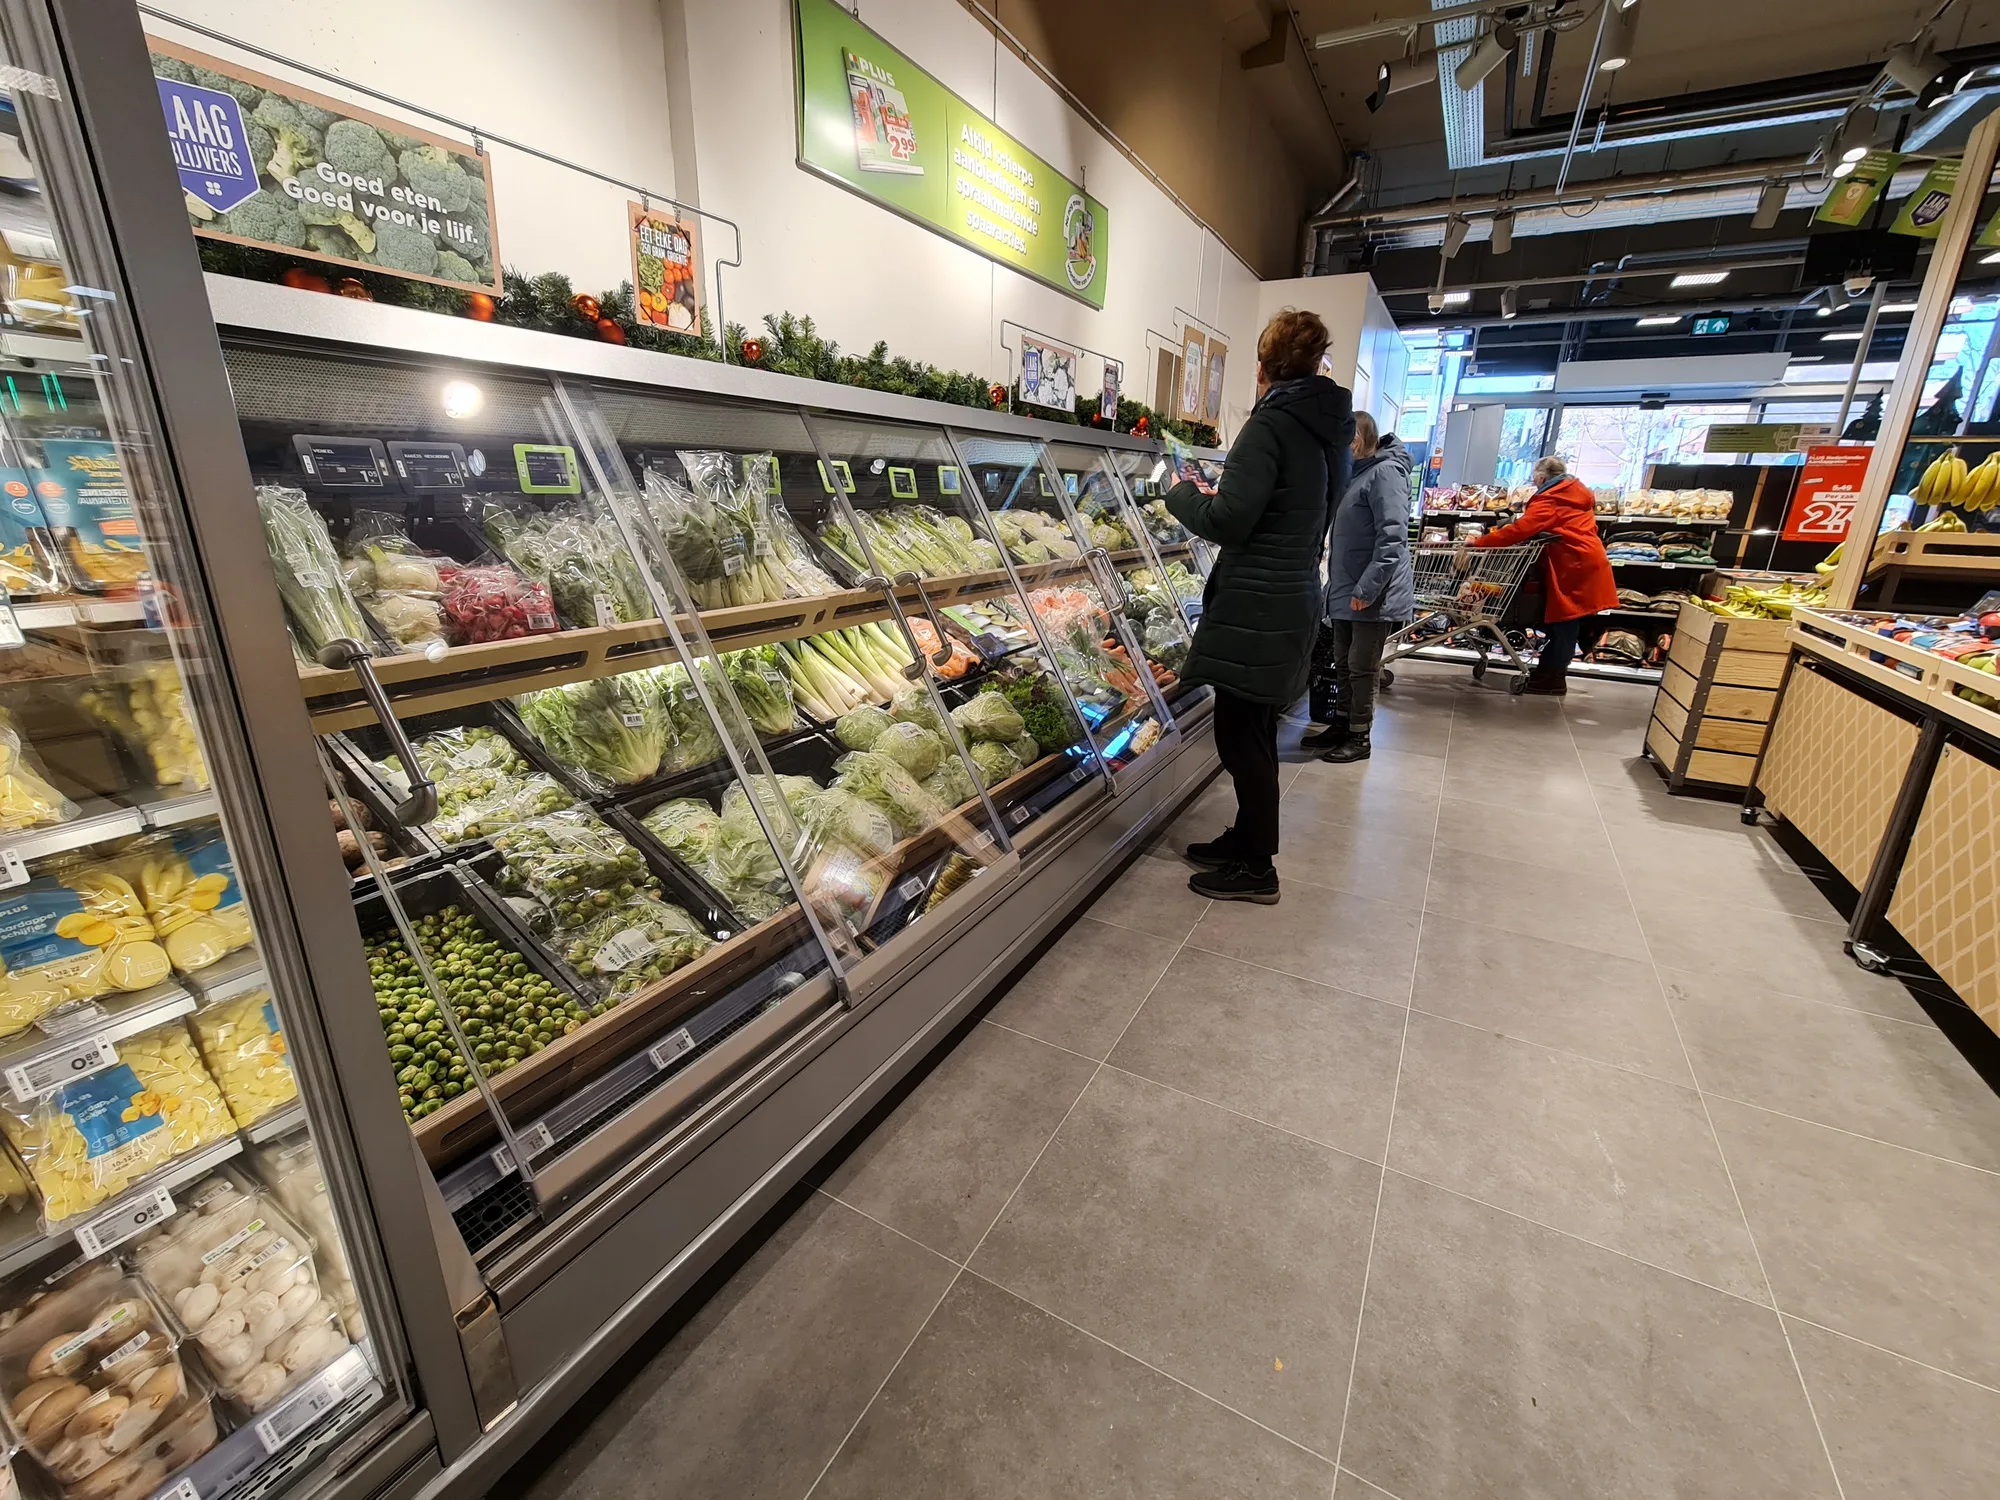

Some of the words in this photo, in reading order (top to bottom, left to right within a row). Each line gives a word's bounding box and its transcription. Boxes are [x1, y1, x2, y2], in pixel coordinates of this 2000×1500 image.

[858, 56, 896, 87] PLUS
[961, 122, 993, 160] Altijd
[995, 150, 1035, 188] scherpe
[315, 161, 385, 197] Goed
[390, 186, 448, 214] eten.
[954, 147, 1028, 208] aanbiedingen
[1028, 196, 1041, 216] en
[282, 176, 355, 213] Goed
[360, 200, 416, 228] voor
[420, 213, 441, 235] je
[446, 219, 479, 244] lijf.
[956, 176, 1039, 237] spraakmakende
[640, 225, 653, 244] EET
[655, 229, 672, 251] ELKE
[673, 235, 688, 256] DAG
[966, 210, 1028, 256] spaaracties.
[71, 1050, 100, 1070] 0.89
[134, 1203, 160, 1224] 0.86
